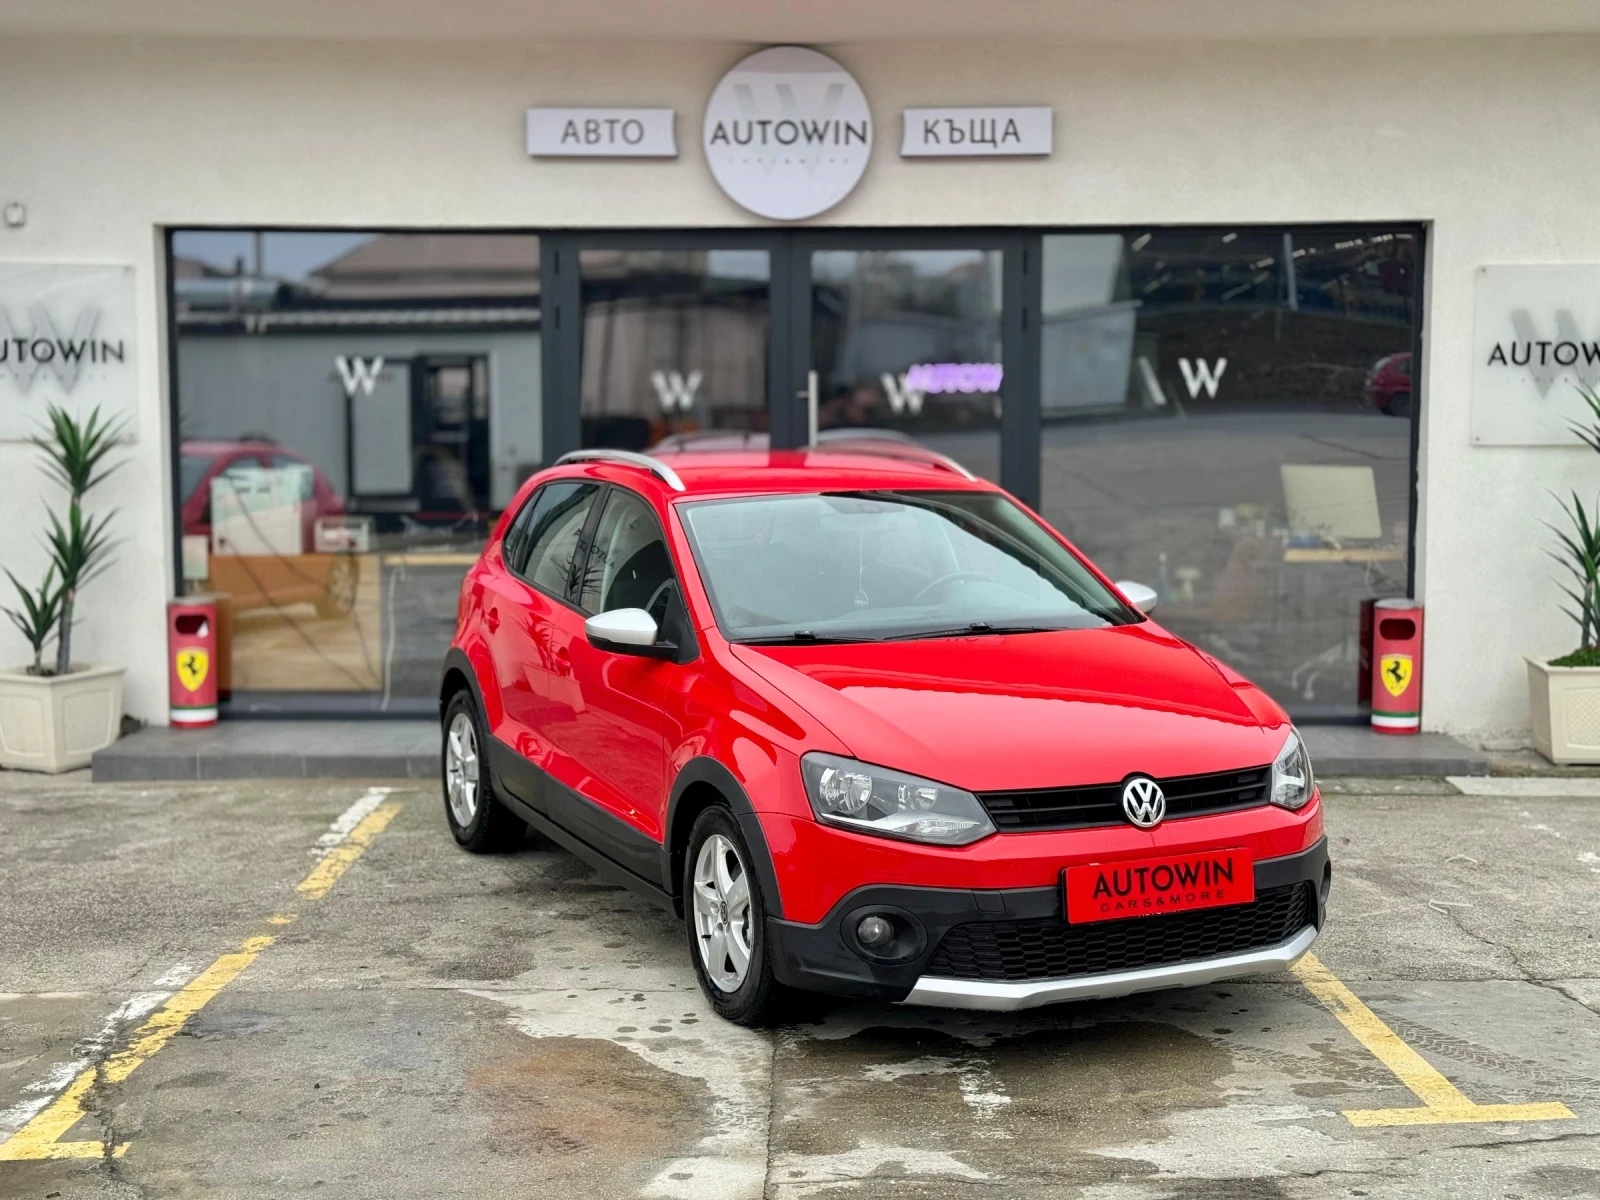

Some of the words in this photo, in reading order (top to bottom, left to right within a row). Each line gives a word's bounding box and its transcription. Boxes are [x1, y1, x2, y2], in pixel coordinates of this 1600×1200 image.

[560, 118, 645, 146] АВТО
[709, 119, 868, 146] AUTOWIN
[923, 118, 1022, 149] КЪЩА
[334, 354, 383, 397] W
[651, 369, 703, 411] W
[1178, 357, 1228, 399] W
[1092, 857, 1234, 900] AUTOWIN
[1101, 888, 1225, 913] CARS&MORE
